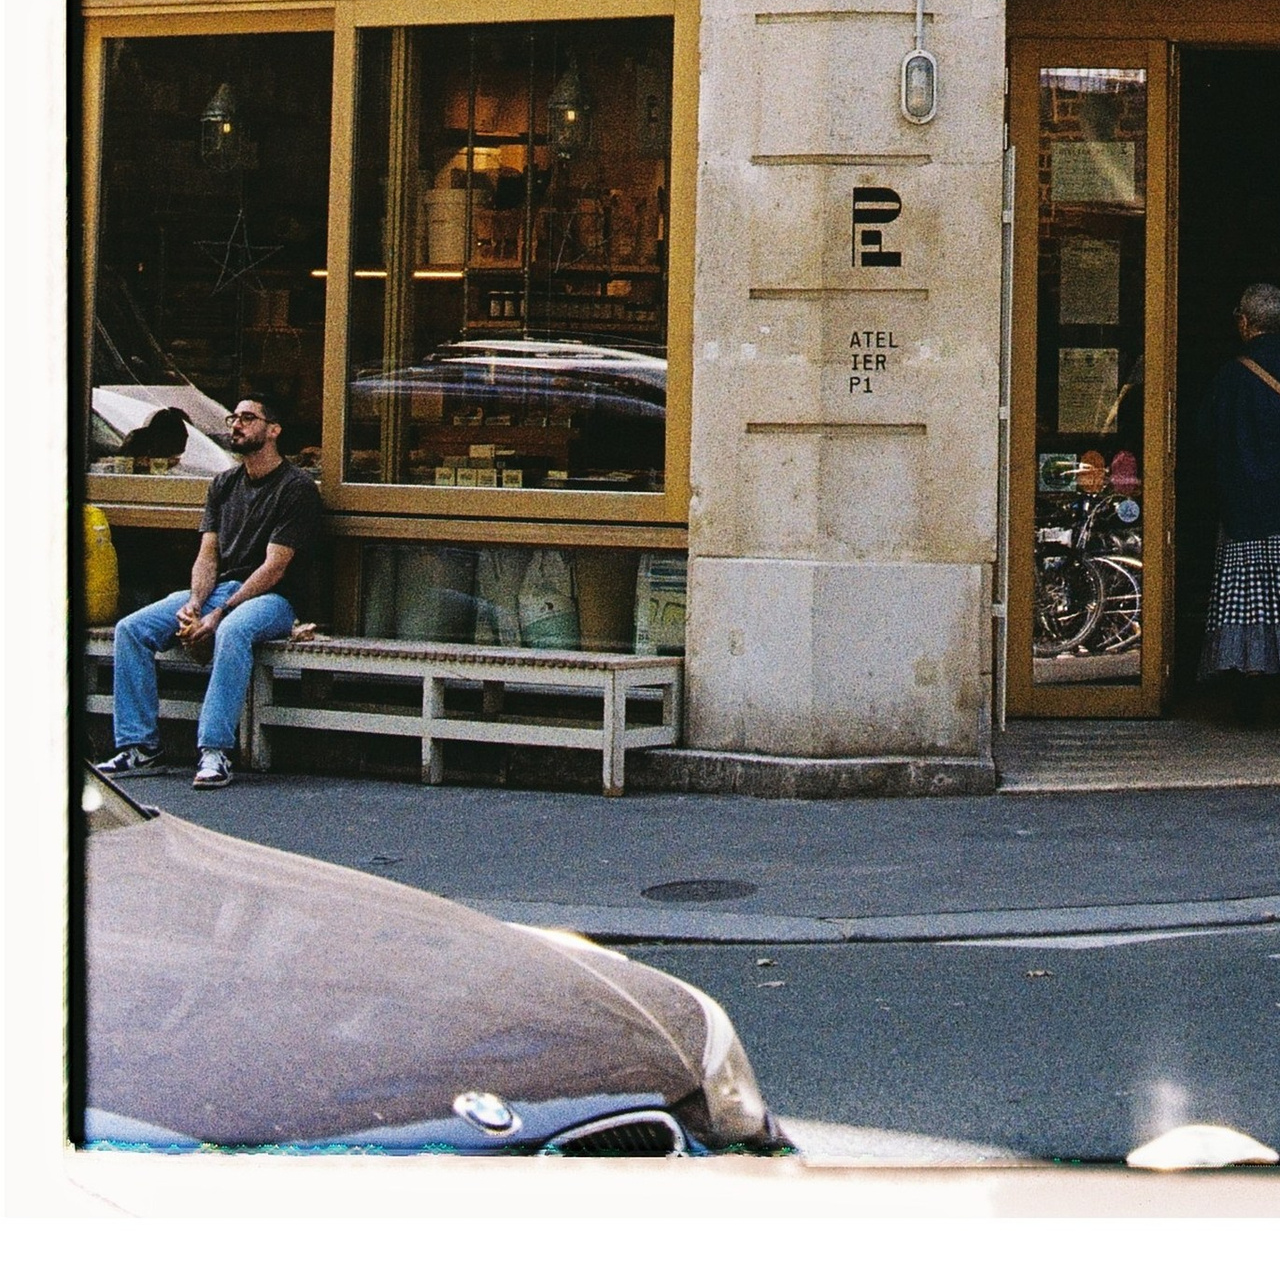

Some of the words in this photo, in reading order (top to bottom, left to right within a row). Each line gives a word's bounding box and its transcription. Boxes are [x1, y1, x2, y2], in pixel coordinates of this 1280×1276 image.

[849, 331, 899, 349] ATEL
[850, 354, 886, 371] IER
[849, 376, 873, 394] P1
